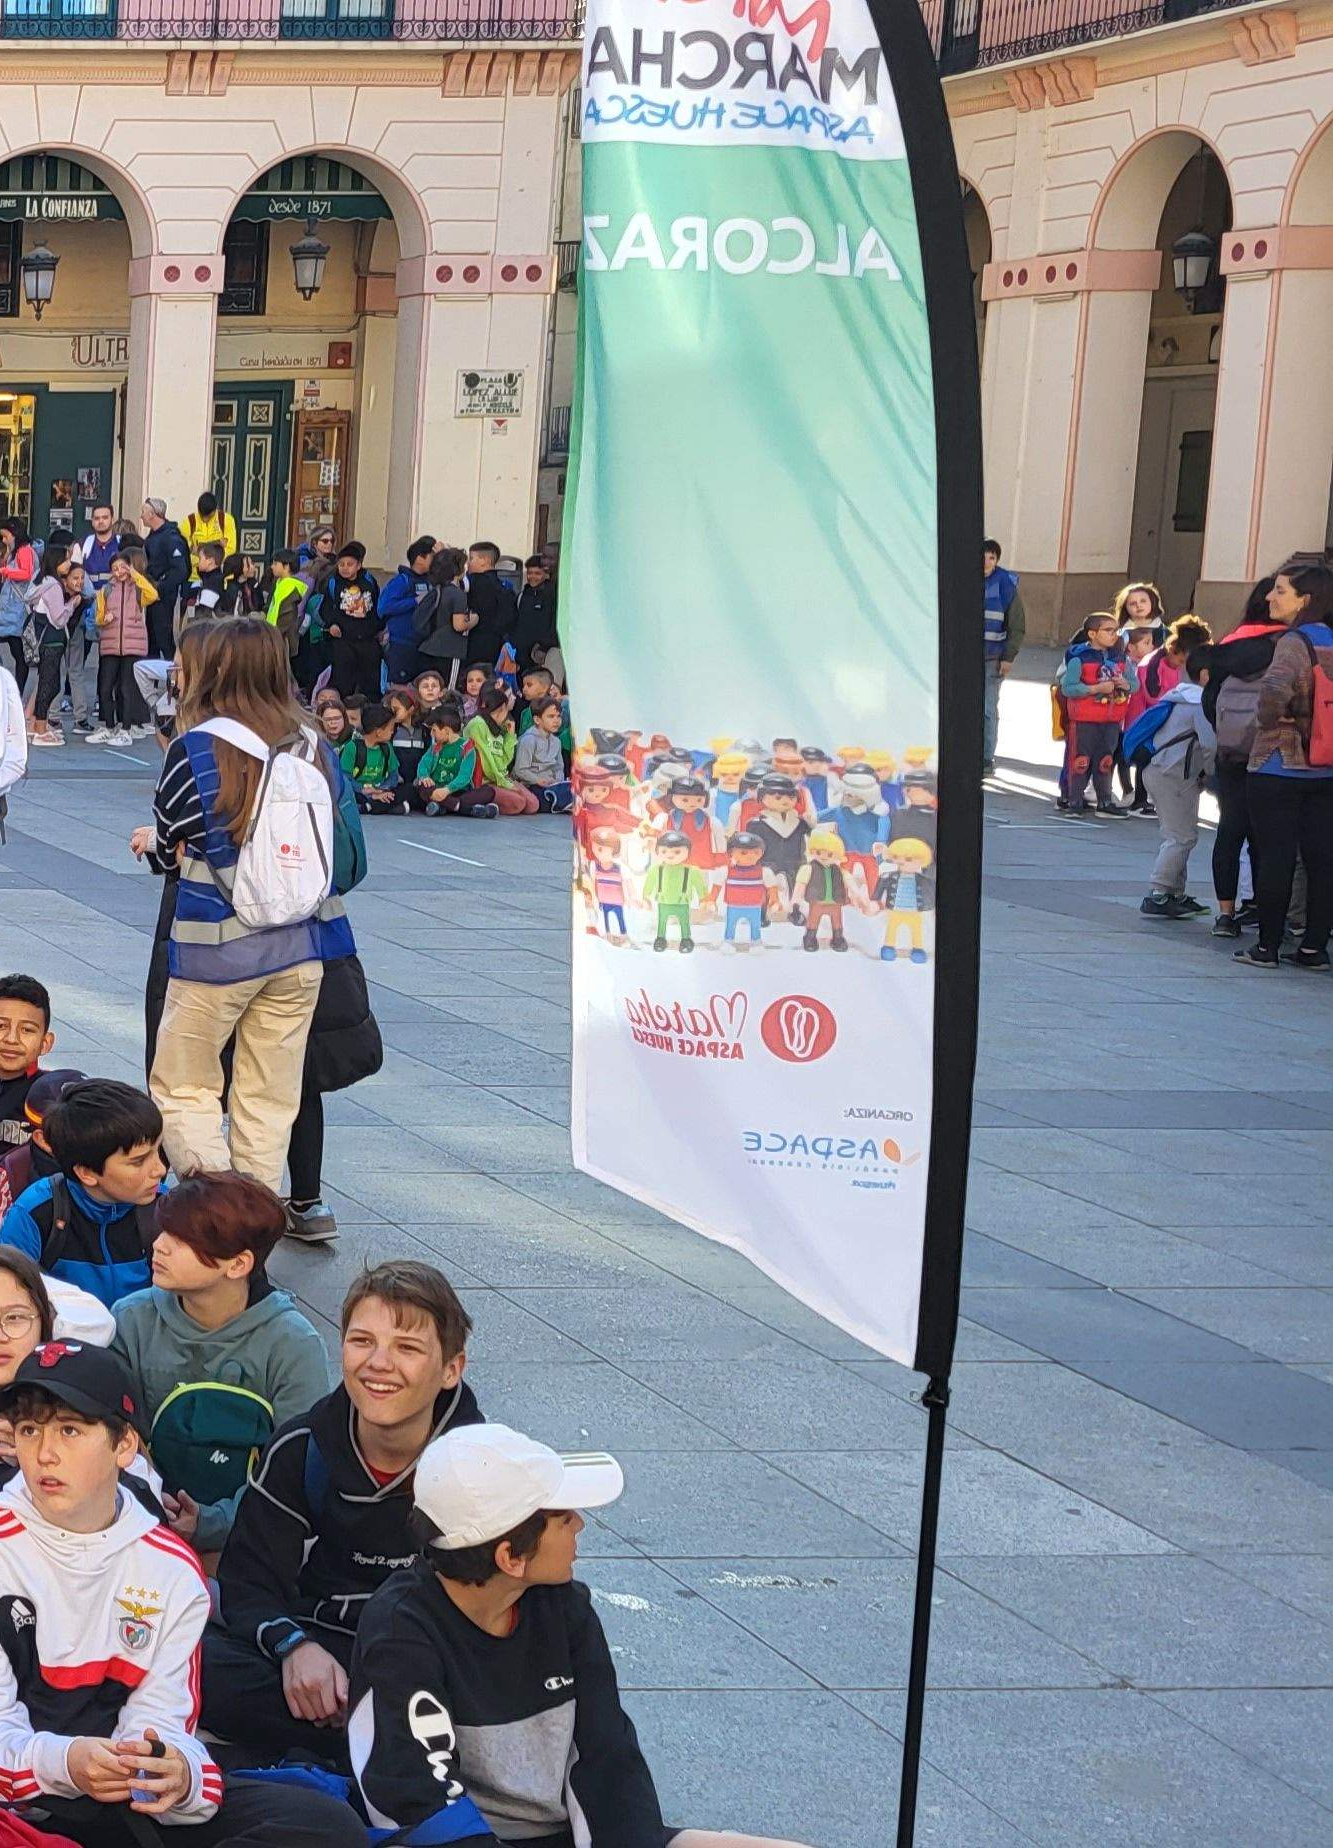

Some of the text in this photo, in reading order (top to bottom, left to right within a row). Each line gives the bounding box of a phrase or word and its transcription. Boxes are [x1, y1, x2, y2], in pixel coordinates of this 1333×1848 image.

[25, 197, 38, 218] LA
[41, 197, 98, 218] CONFIANZA
[268, 198, 331, 215] desde 1871
[306, 357, 321, 367] 1871
